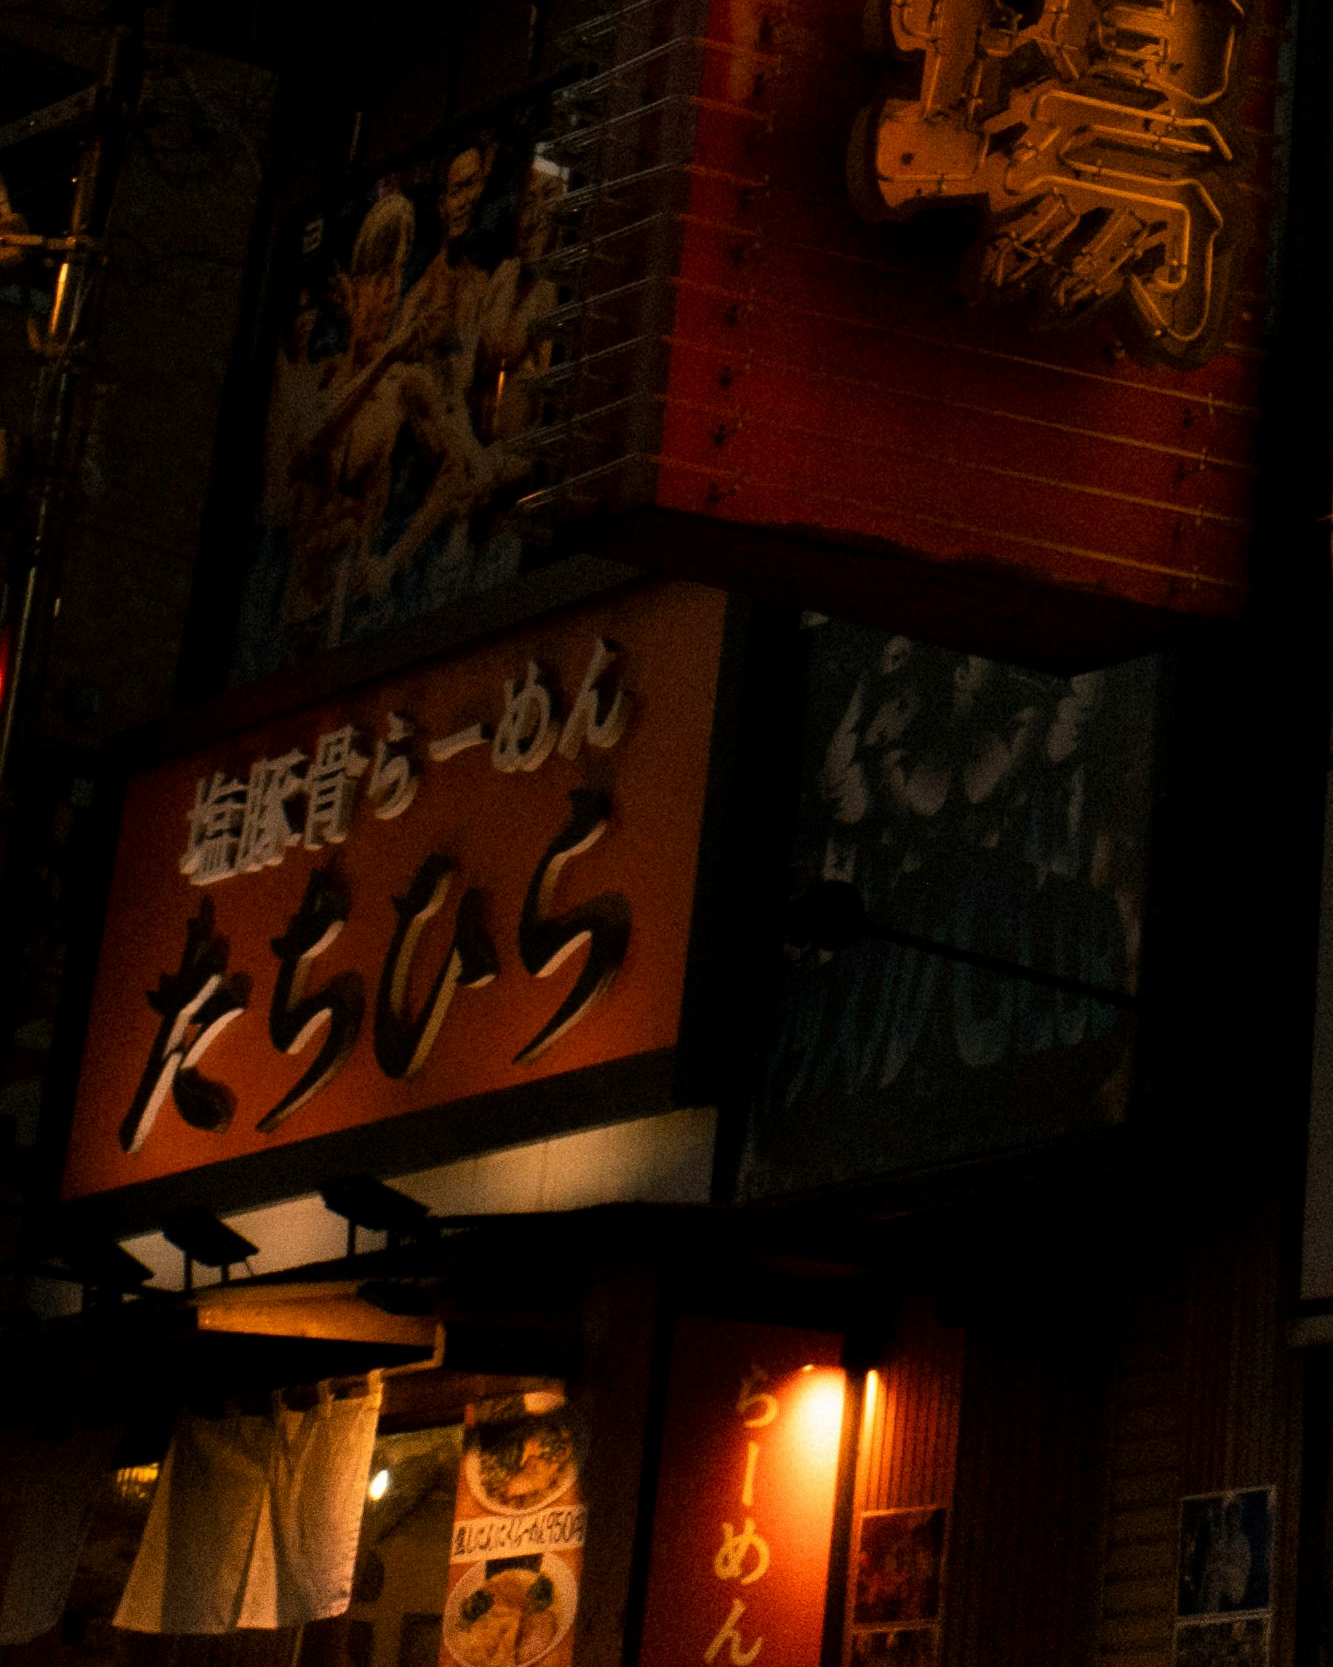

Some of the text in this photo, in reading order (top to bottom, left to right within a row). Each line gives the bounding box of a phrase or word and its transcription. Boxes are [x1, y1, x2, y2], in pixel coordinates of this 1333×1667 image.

[184, 638, 628, 886] 塩豚骨らーめん
[120, 782, 633, 1155] たちひら
[703, 1363, 779, 1666] らーめん
